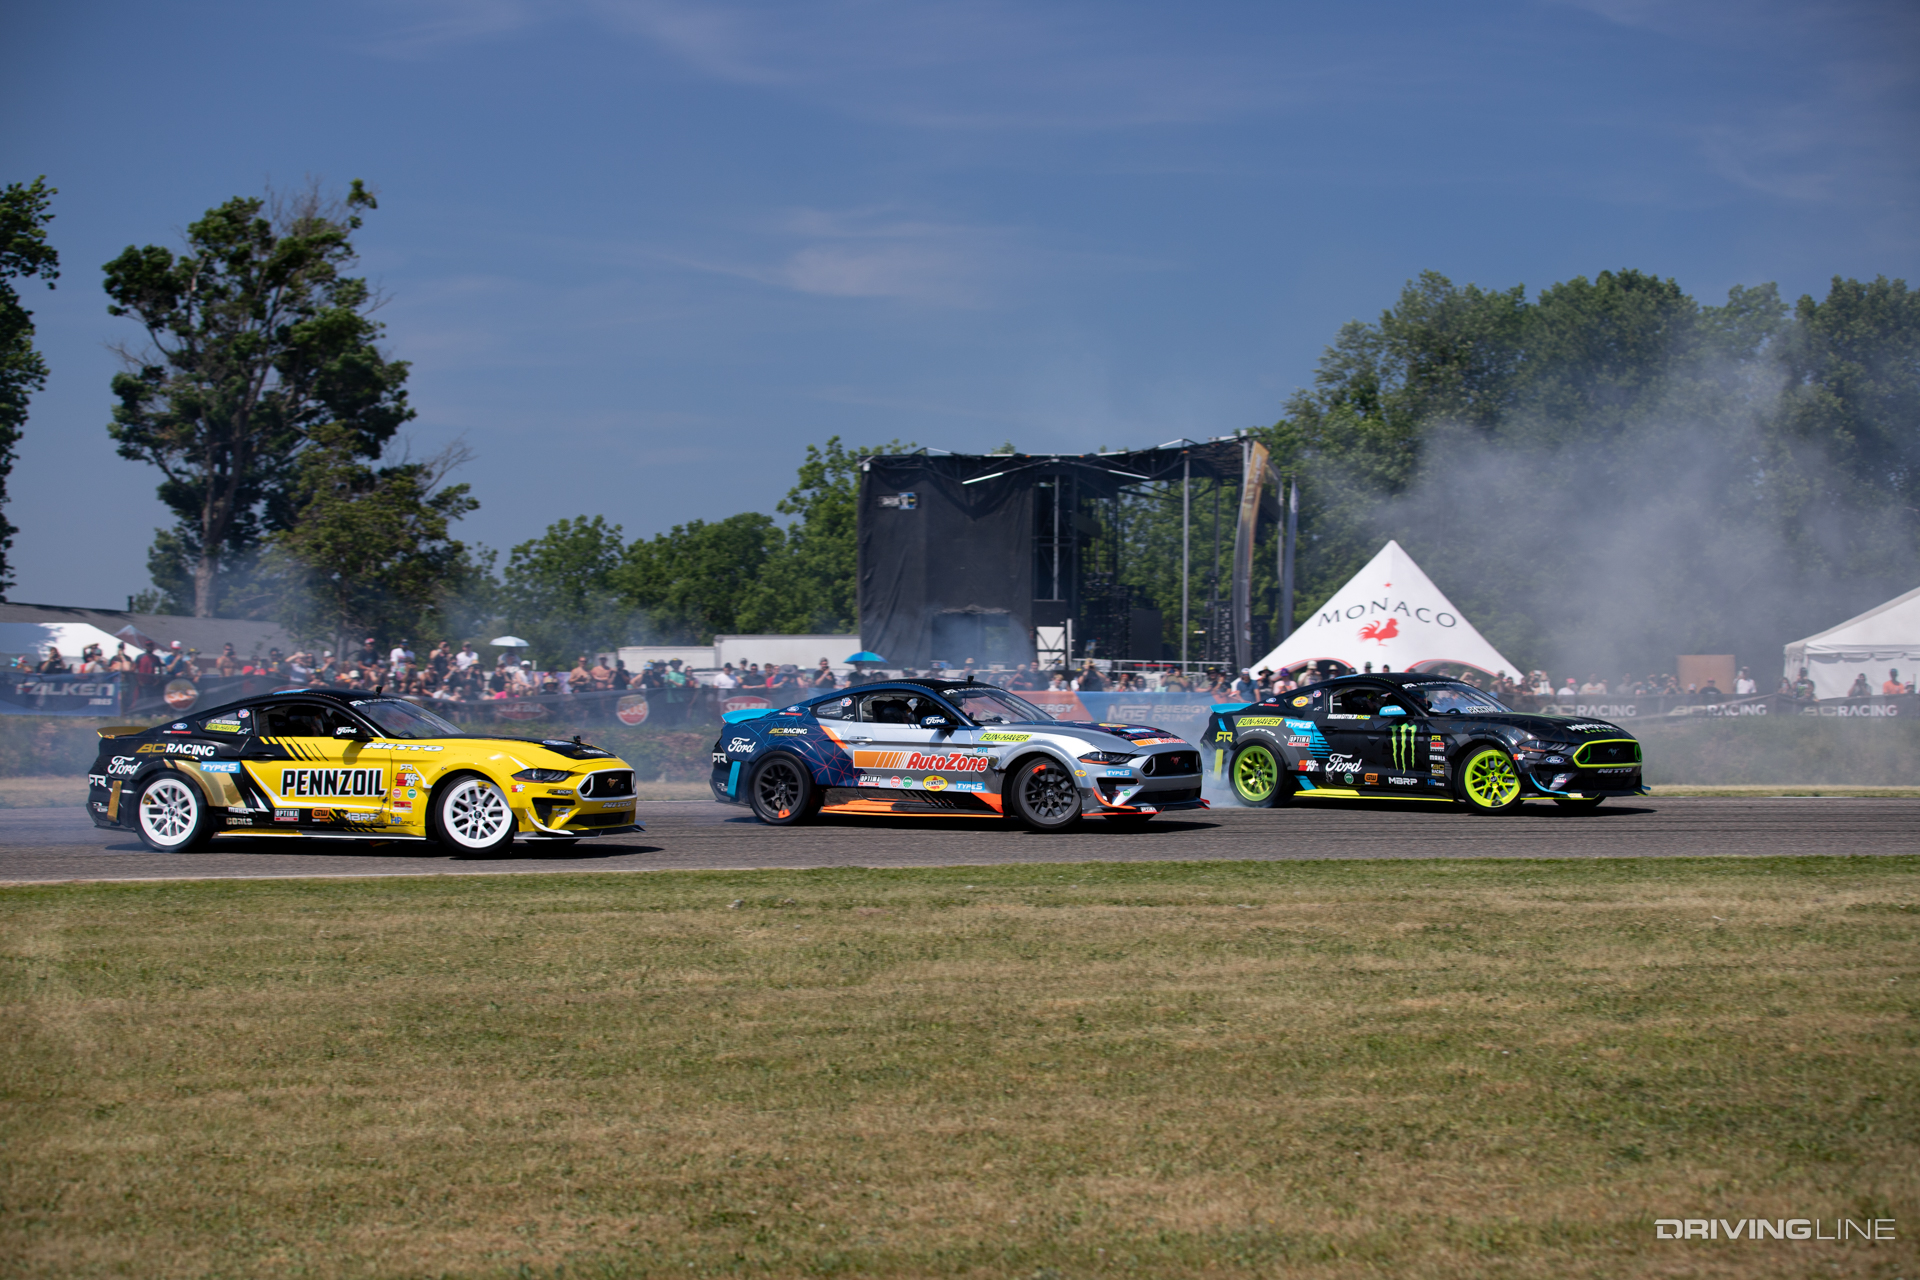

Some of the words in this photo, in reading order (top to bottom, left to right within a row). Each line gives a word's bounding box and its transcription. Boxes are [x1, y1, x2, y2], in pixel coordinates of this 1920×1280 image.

[1317, 597, 1457, 628] MONACO
[16, 682, 114, 696] FALKEN
[1106, 704, 1152, 722] NOS
[1153, 704, 1208, 713] ENERGY
[1576, 704, 1637, 717] RACING
[1837, 704, 1898, 717] RACING
[925, 716, 946, 725] Ford
[1151, 713, 1195, 722] DRINK
[336, 726, 358, 735] Ford
[980, 733, 1031, 742] FUN-HAVER
[165, 743, 216, 757] RACING
[360, 742, 445, 752] NITTO
[727, 736, 757, 753] Ford
[107, 755, 143, 775] Ford
[905, 751, 989, 773] AutoZone
[1325, 753, 1363, 773] Ford
[281, 767, 388, 798] PENNZOIL
[1388, 776, 1418, 786] MBRP
